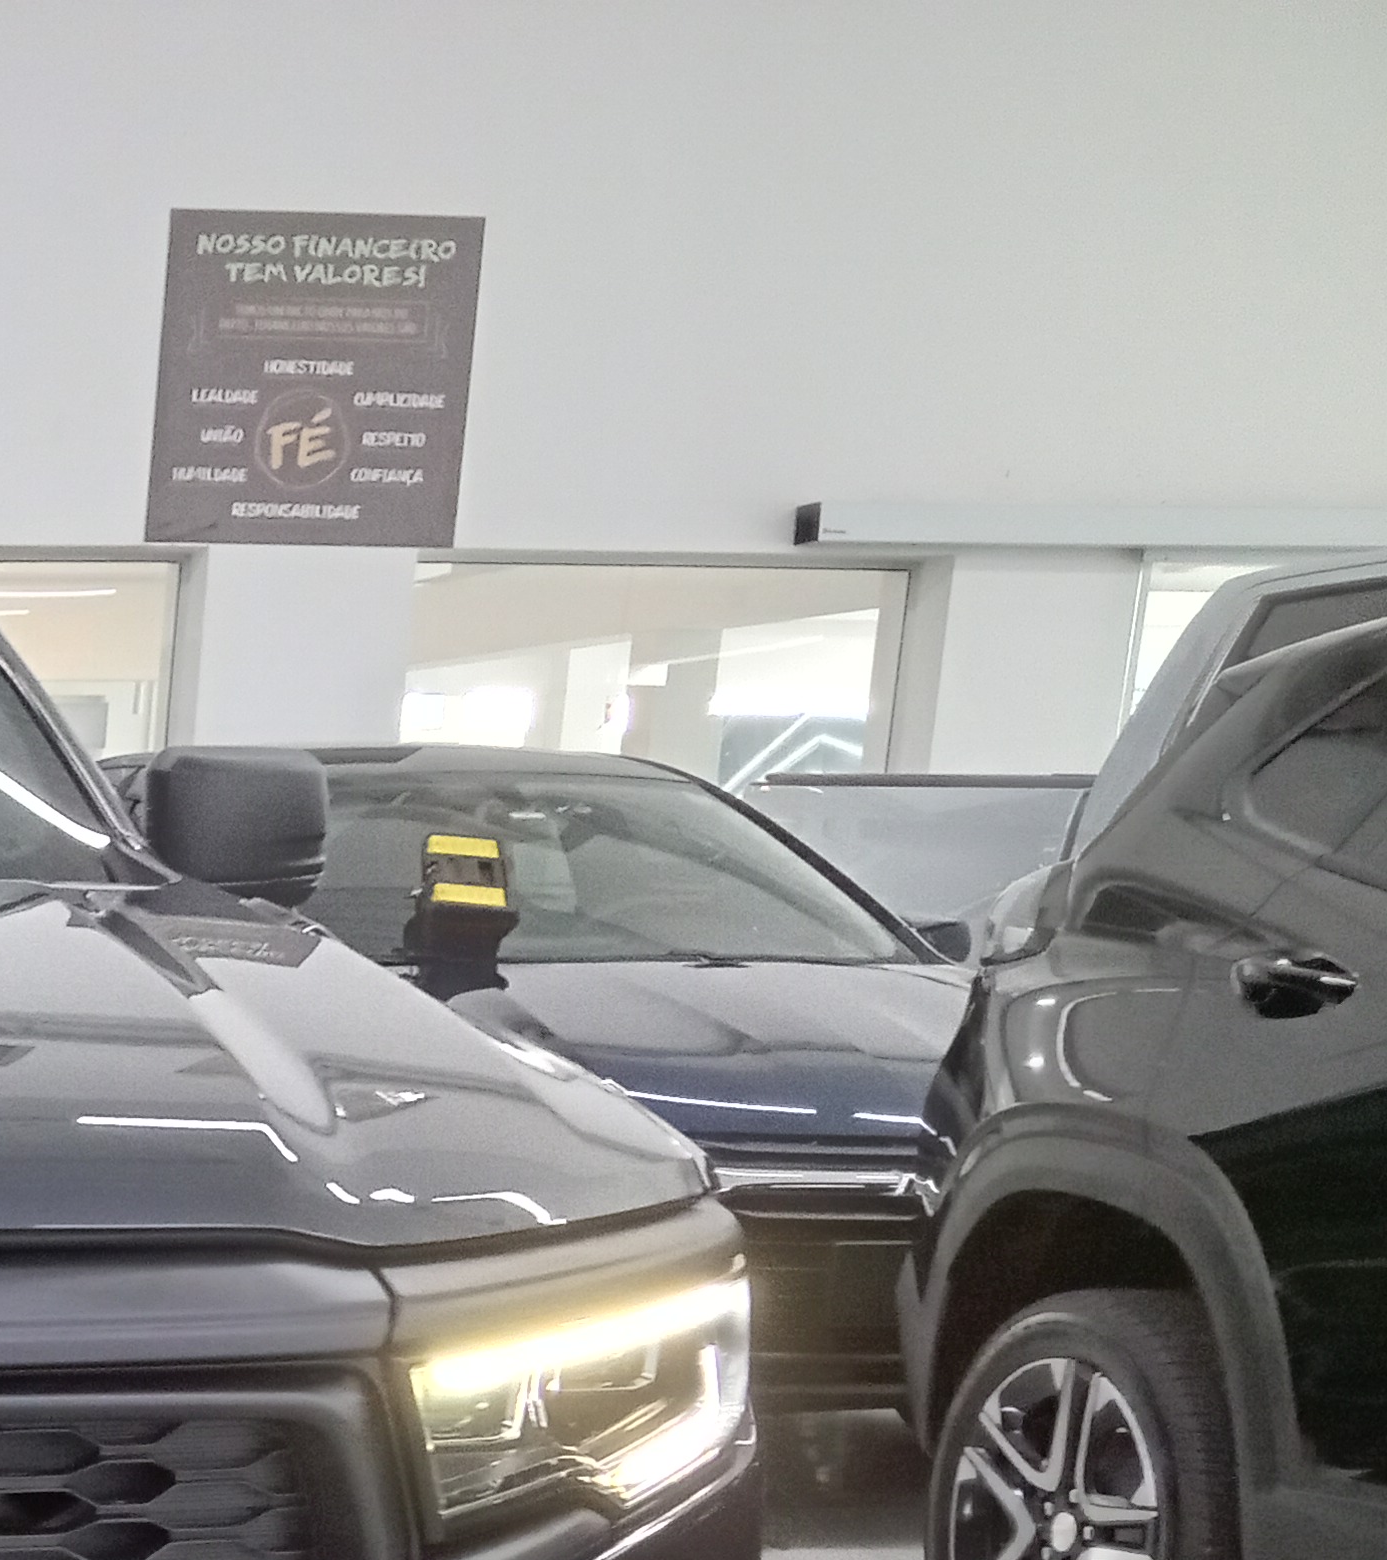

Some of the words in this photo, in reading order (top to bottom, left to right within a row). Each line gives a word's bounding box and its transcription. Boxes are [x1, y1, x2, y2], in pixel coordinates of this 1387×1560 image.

[196, 233, 286, 255] NOSSO
[292, 235, 457, 262] FINANCEIRO
[226, 262, 287, 283] TEM
[293, 264, 427, 288] VALORES!
[264, 360, 354, 375] HONESTIDADE
[191, 388, 258, 404] LEALDADE
[353, 391, 445, 409] CUMPLICIDADE
[200, 424, 244, 443] UNIÃO
[266, 407, 336, 470] FÉ
[362, 432, 426, 447] RESPEITO
[172, 466, 248, 482] HUMILDADE
[350, 468, 424, 486] CONFIANÇA
[231, 501, 361, 520] RESPONSABILIDADE
